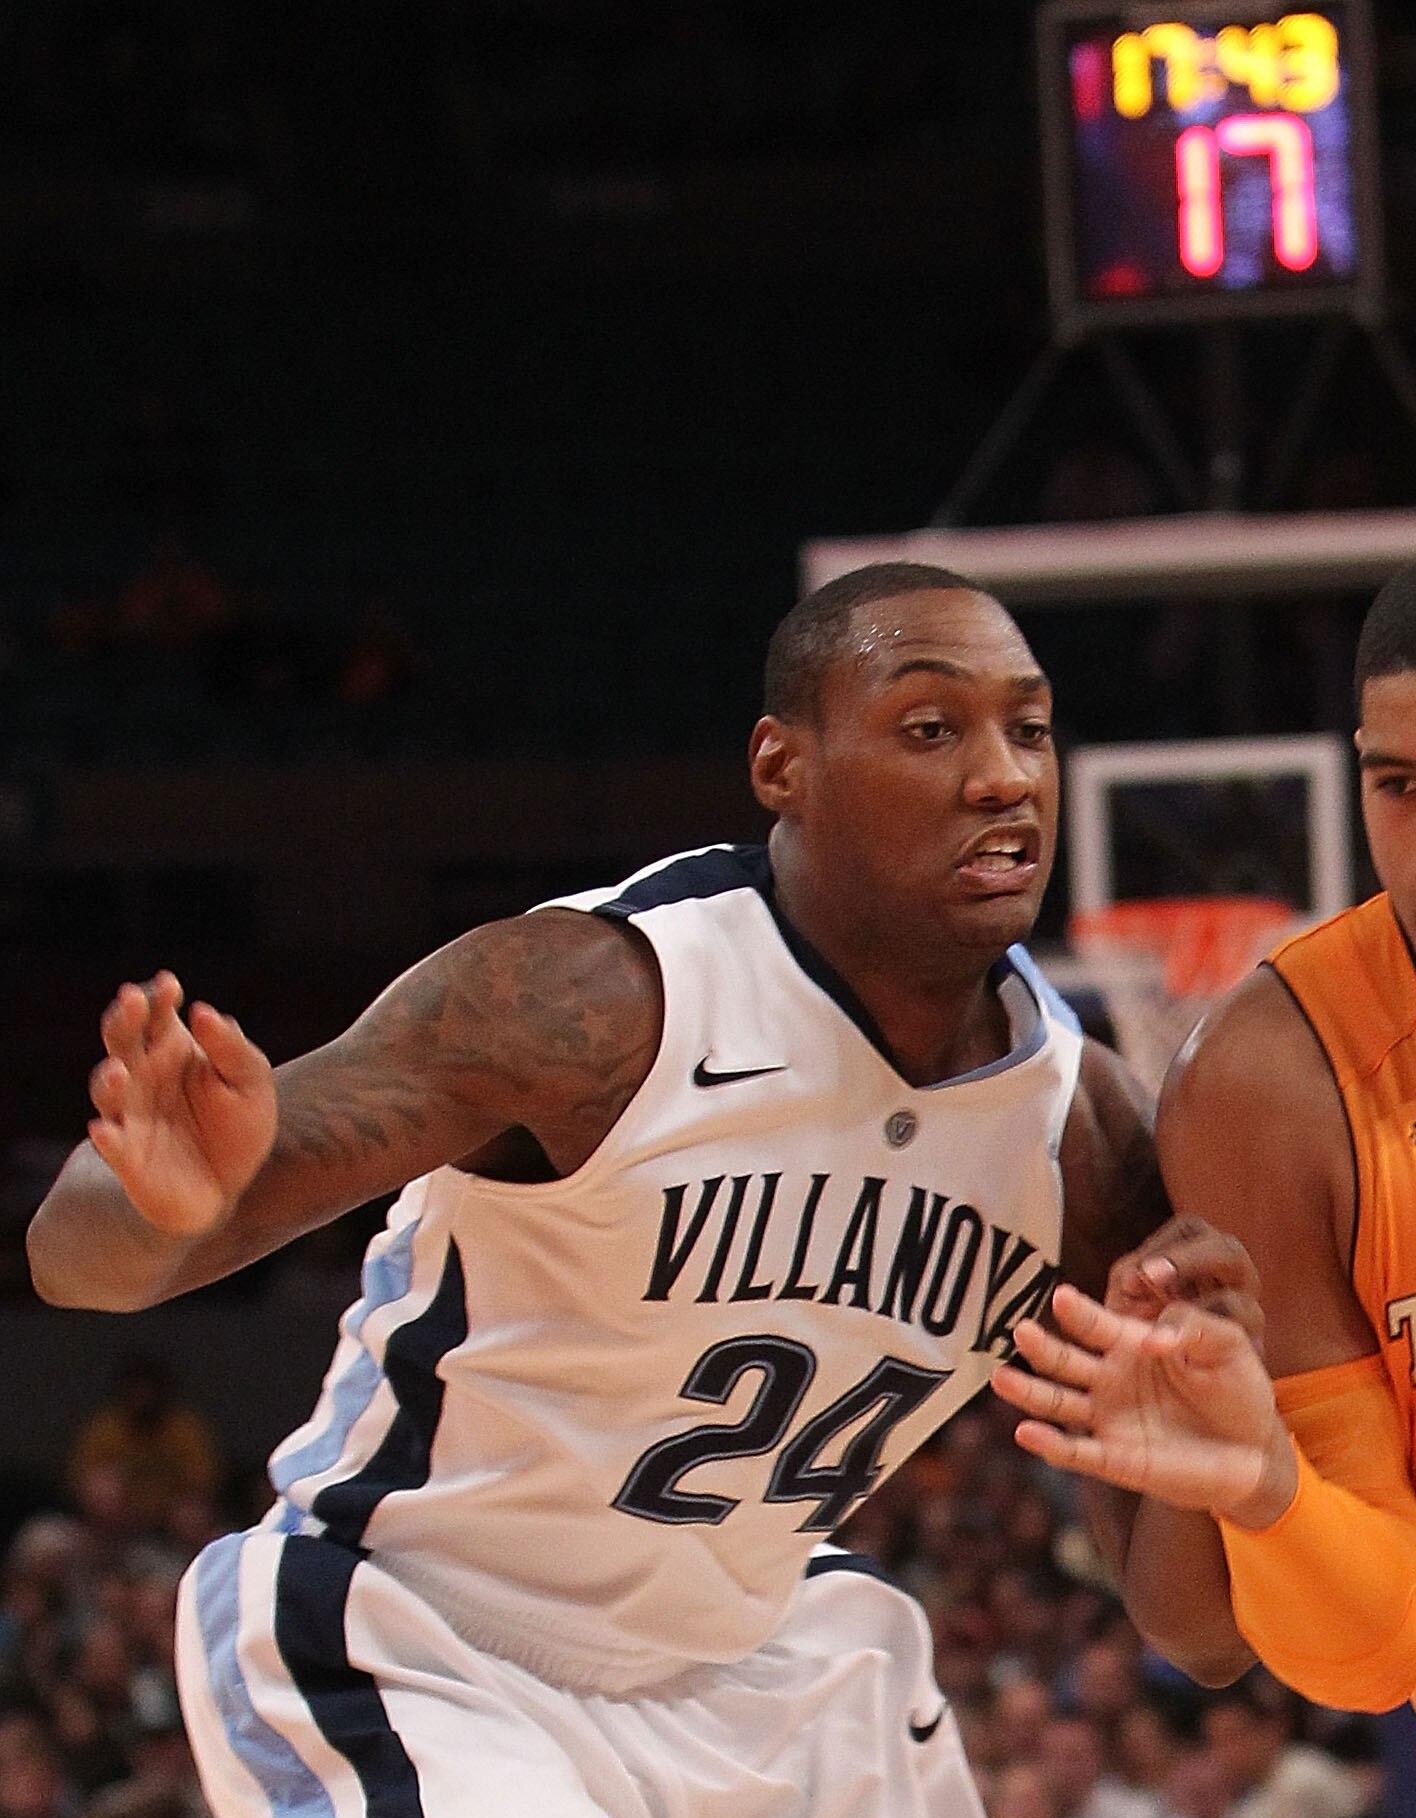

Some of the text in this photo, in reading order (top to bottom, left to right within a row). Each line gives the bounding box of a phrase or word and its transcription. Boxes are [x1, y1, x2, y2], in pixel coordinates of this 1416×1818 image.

[1175, 111, 1319, 278] 17
[641, 1171, 1067, 1360] VILLANOVA
[609, 1334, 955, 1533] 24
